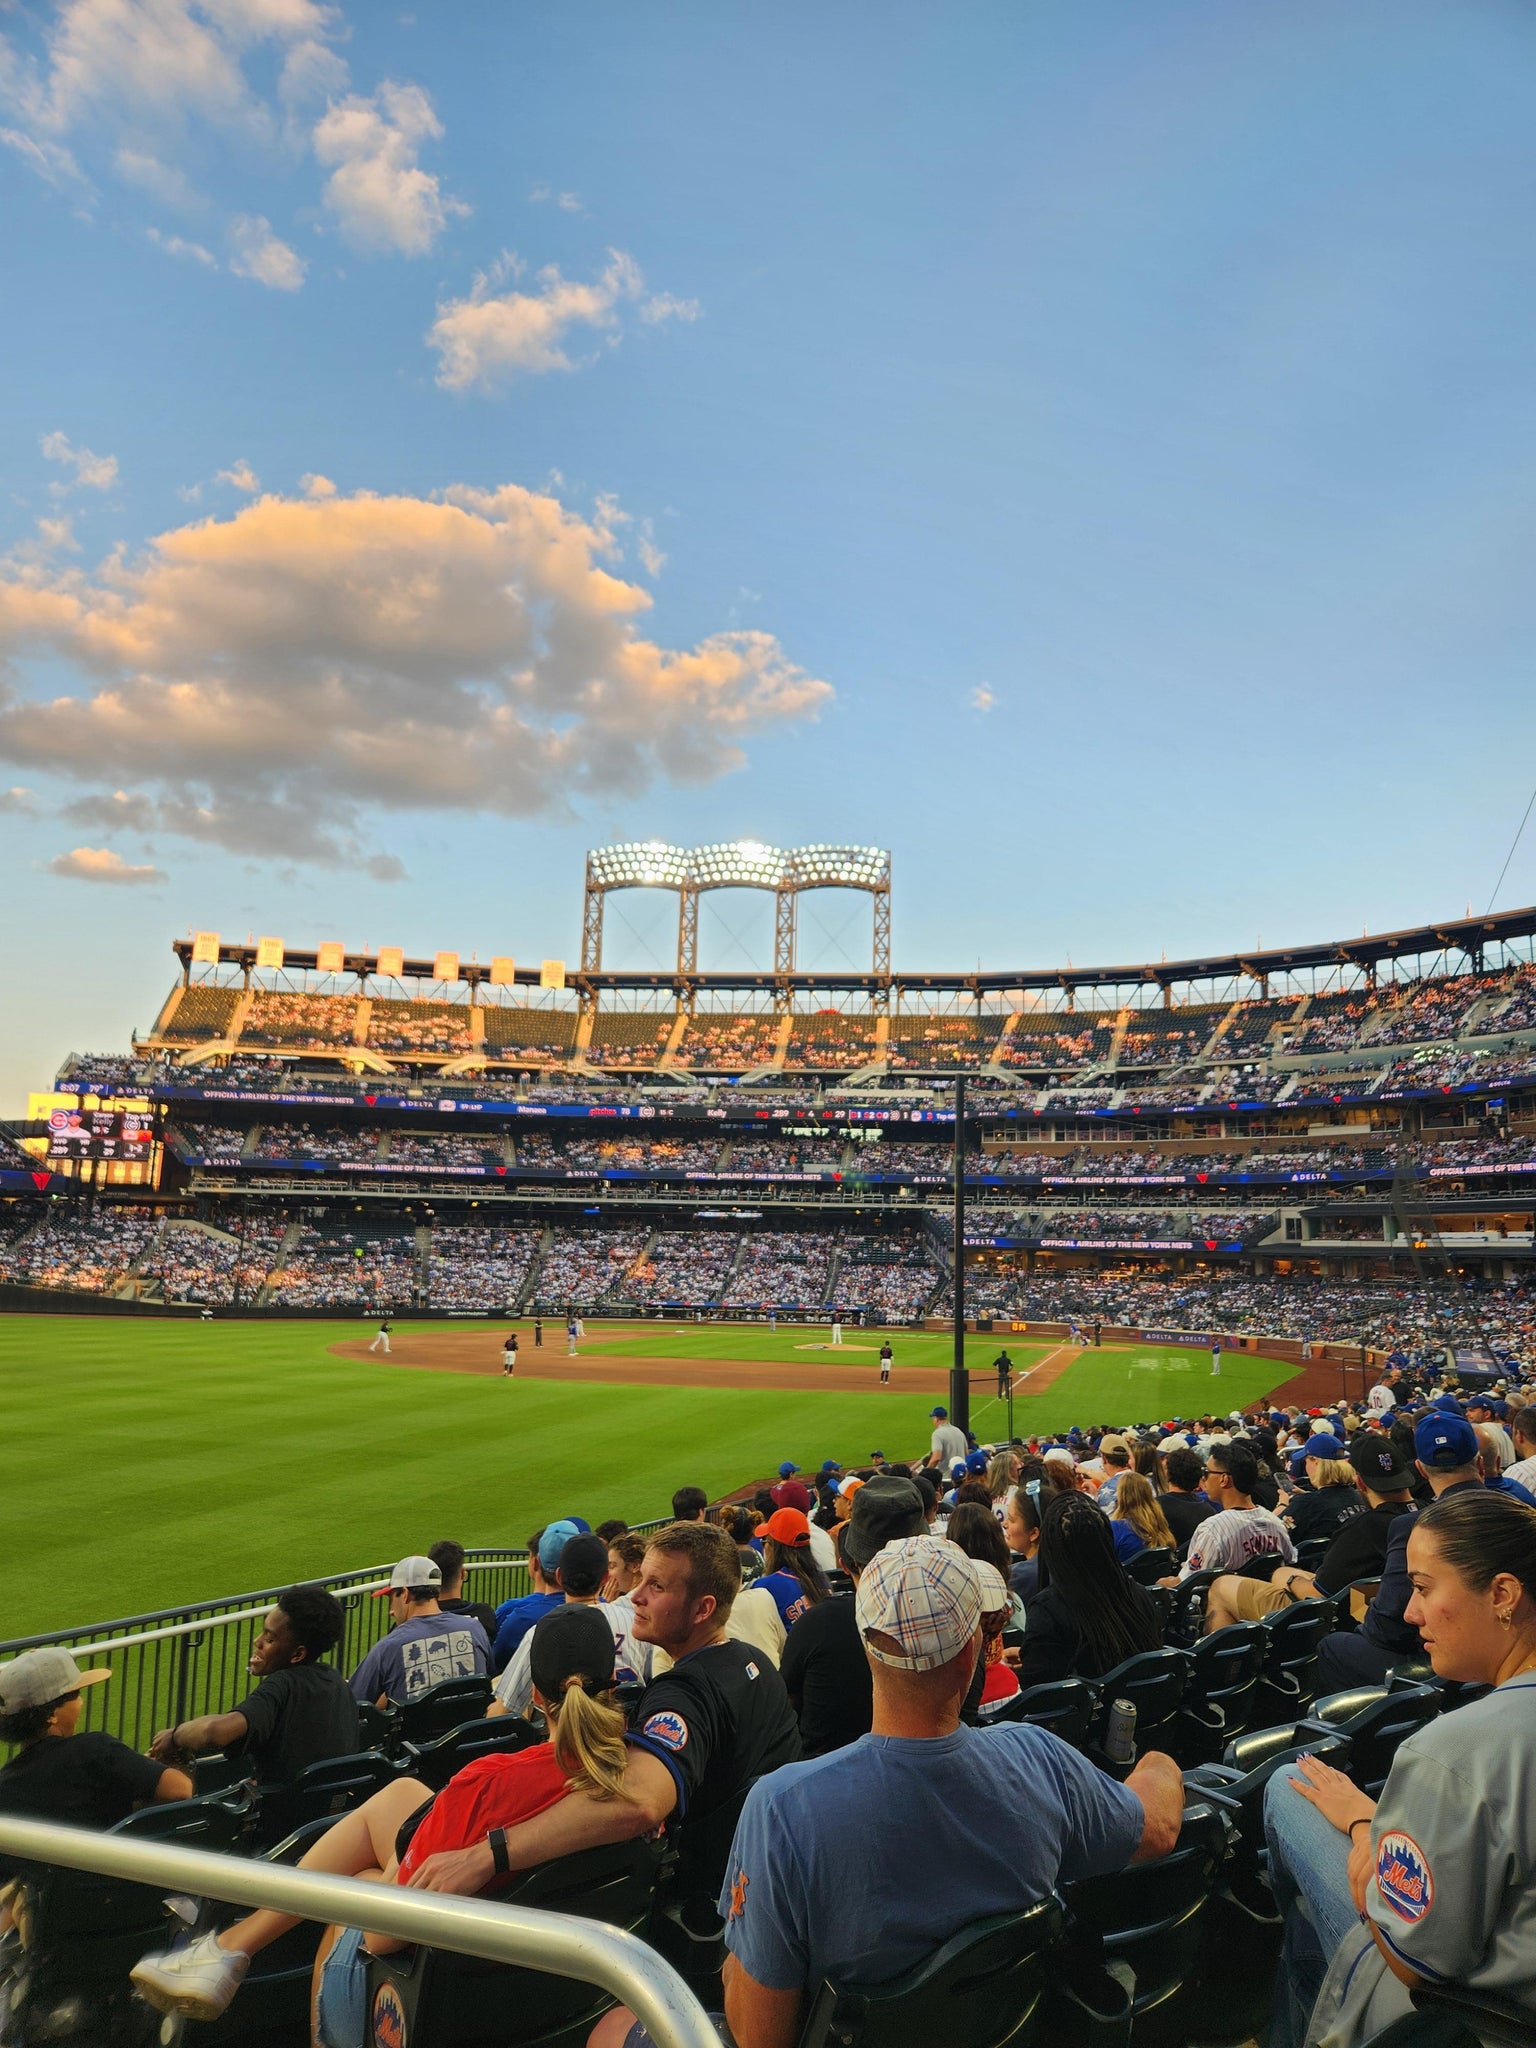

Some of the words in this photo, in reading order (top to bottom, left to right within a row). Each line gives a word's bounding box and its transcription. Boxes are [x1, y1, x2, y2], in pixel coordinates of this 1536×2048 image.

[126, 1086, 154, 1095] DELTA
[204, 1090, 238, 1099] OFFICIAL
[240, 1092, 269, 1100] AIRLINE
[707, 1109, 727, 1118] Kelly
[1465, 1166, 1494, 1174] AIRLINE
[1383, 1860, 1424, 1902] Mets
